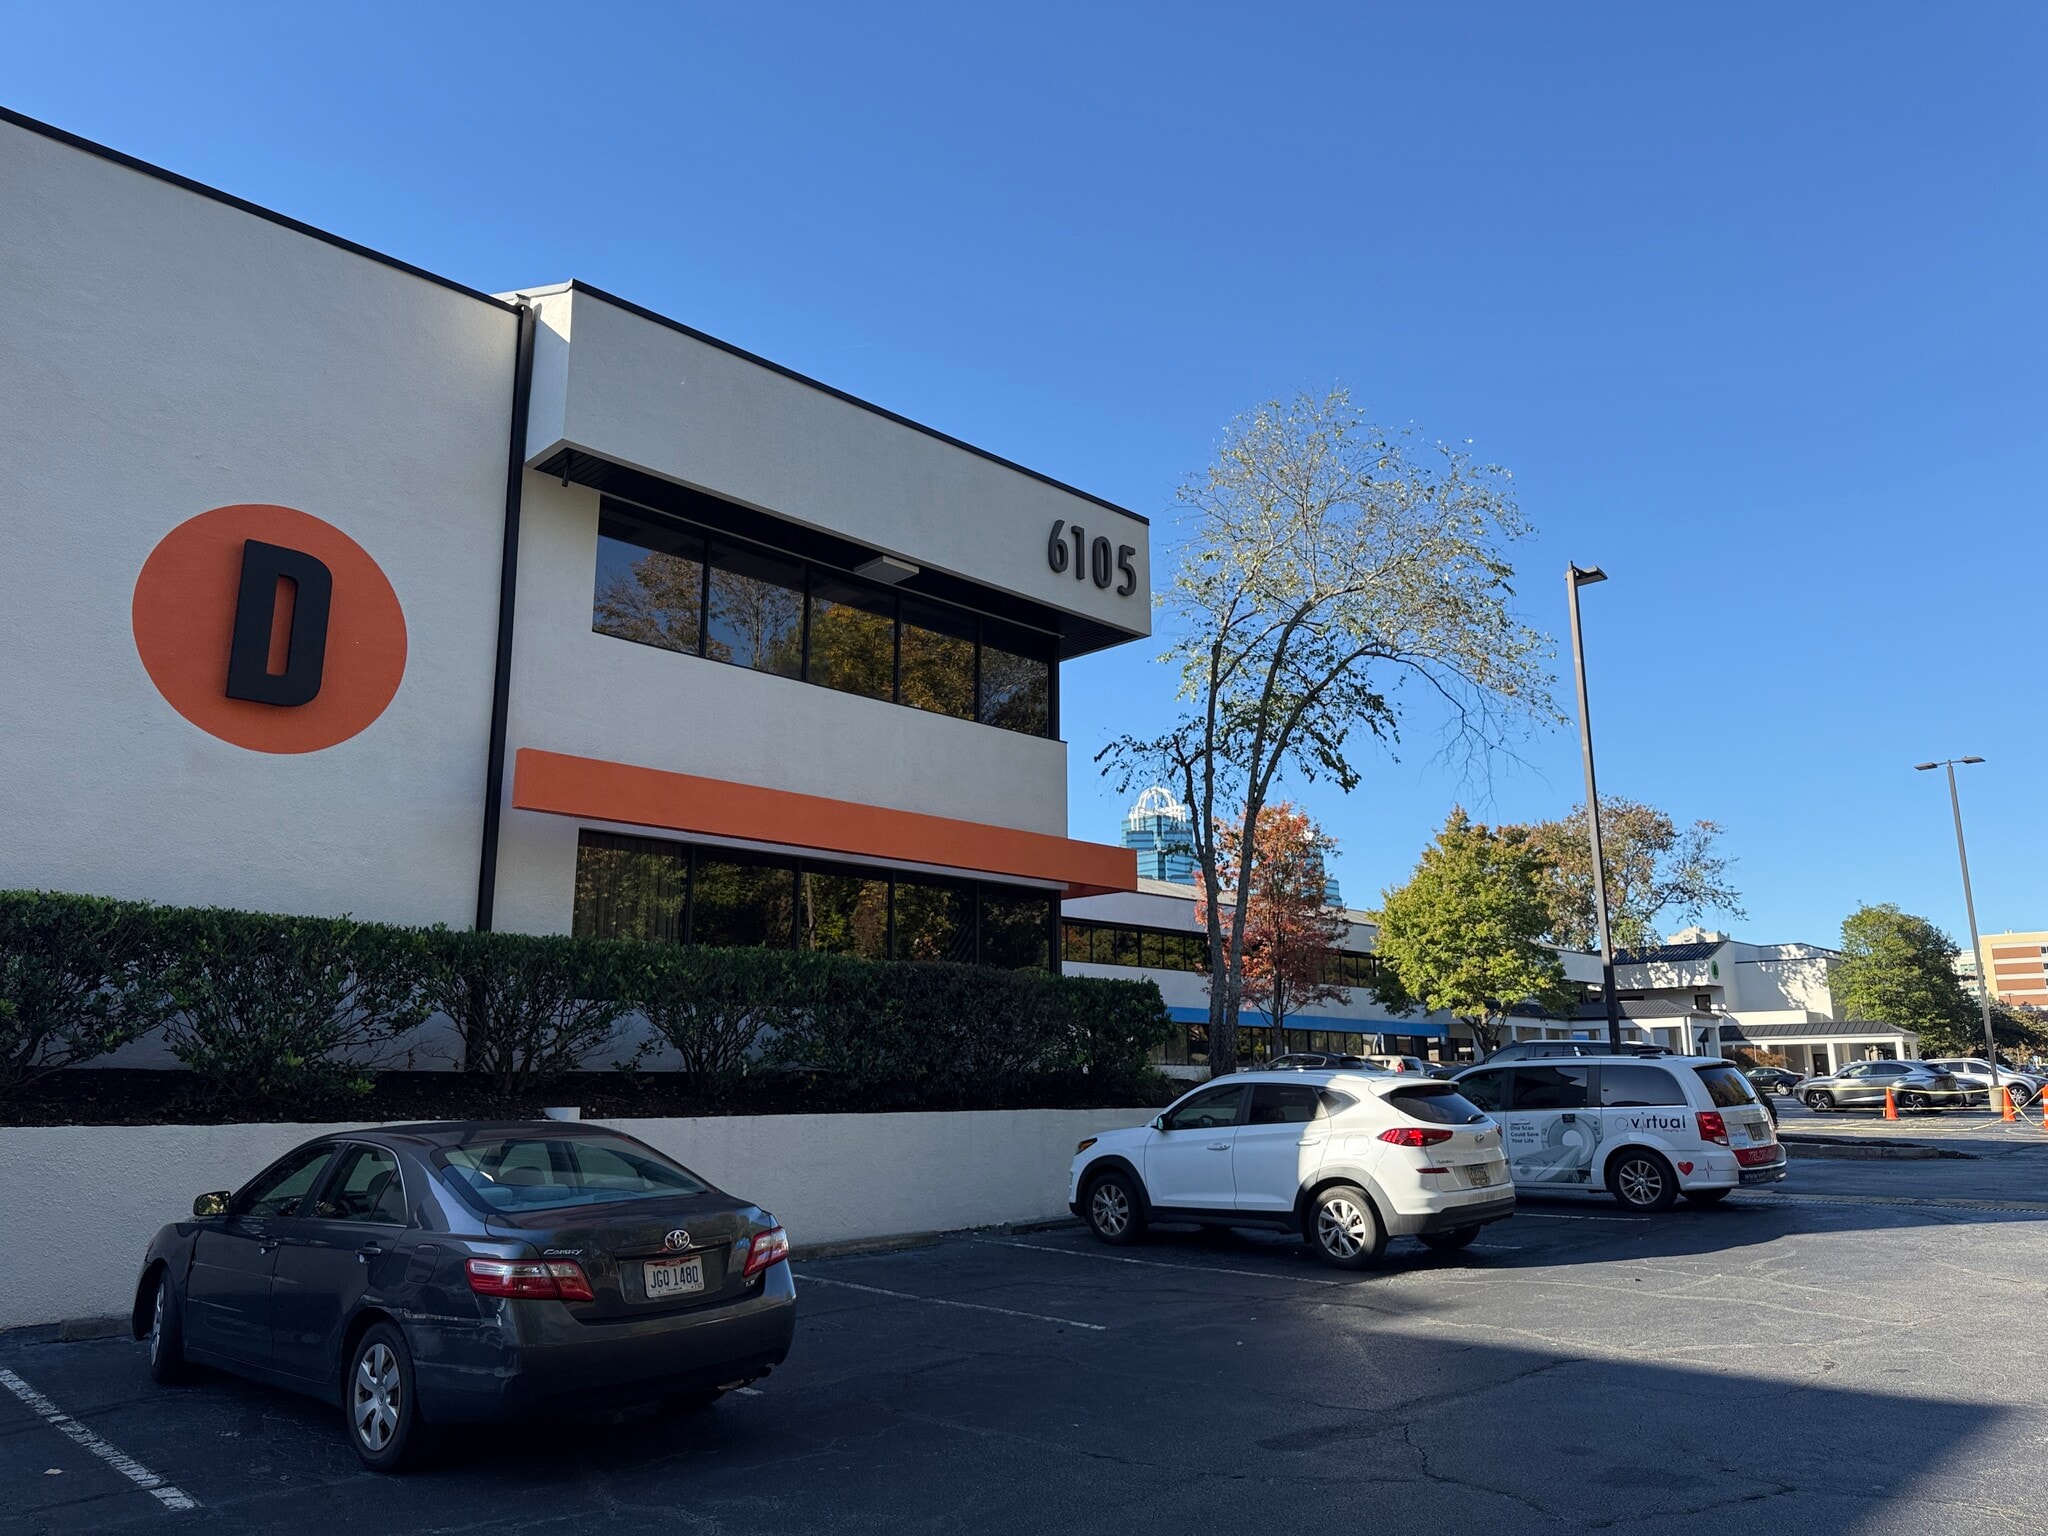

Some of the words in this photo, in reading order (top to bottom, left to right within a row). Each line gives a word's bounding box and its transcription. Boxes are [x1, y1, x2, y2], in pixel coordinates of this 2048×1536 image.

[1047, 519, 1137, 597] 6105
[225, 538, 333, 708] D
[1630, 1111, 1687, 1131] virtual
[650, 1269, 670, 1289] JGQ
[673, 1265, 699, 1286] 1480
